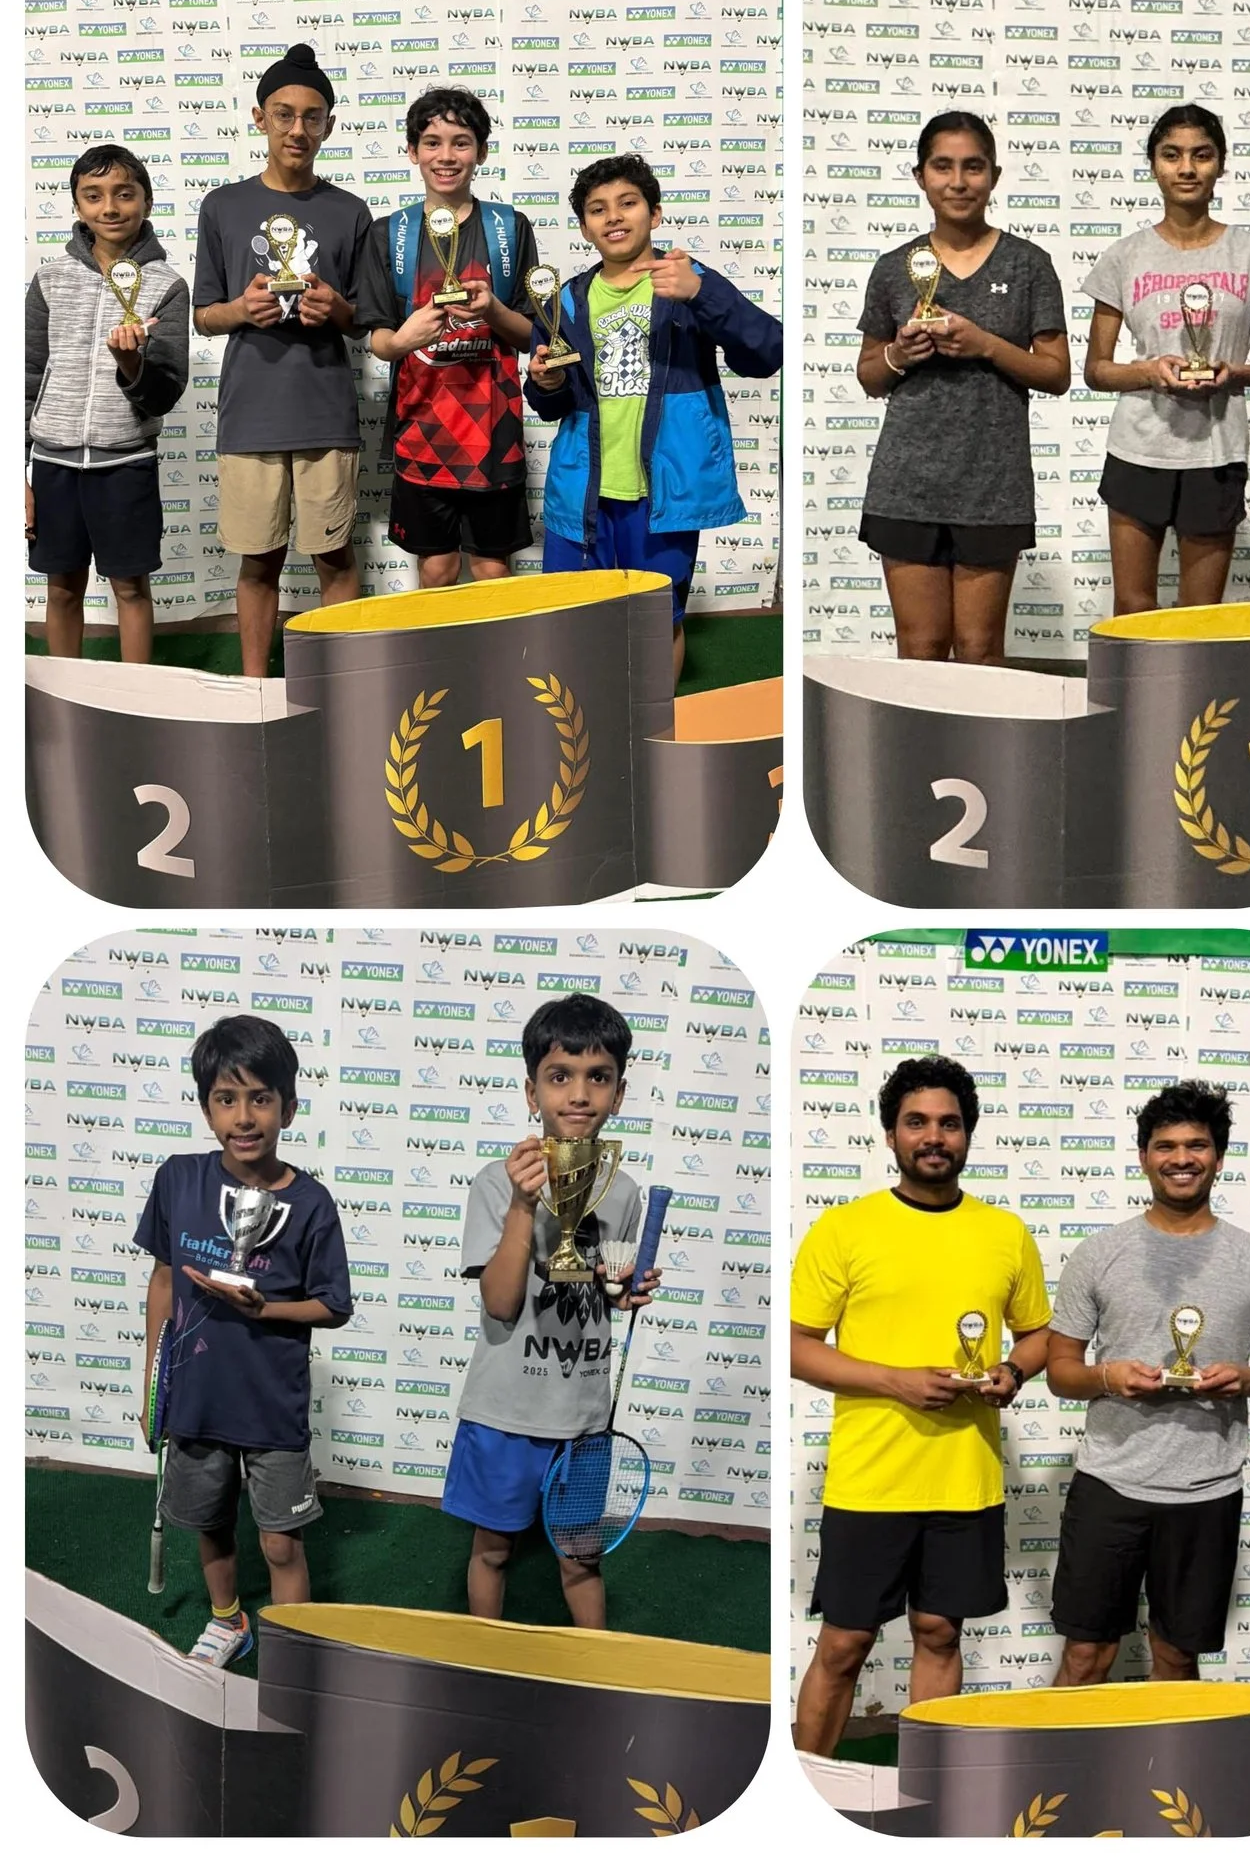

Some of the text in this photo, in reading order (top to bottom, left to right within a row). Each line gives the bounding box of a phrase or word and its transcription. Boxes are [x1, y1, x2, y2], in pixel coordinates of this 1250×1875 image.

[297, 15, 343, 25] NWBA
[431, 217, 453, 226] NWBA
[496, 227, 510, 277] HUNDRED
[531, 276, 554, 286] NWBA
[461, 718, 504, 807] 1
[133, 784, 196, 878] 2
[930, 778, 988, 869] 2
[421, 932, 481, 949] NWBA
[514, 938, 555, 955] YONEX
[110, 948, 169, 965] NWBA
[1022, 939, 1098, 965] YONEX
[201, 956, 238, 972] YONEX
[880, 975, 937, 988] NWBA
[971, 978, 1003, 991] YONEX
[1148, 983, 1178, 997] YONEX
[524, 1335, 611, 1363] NWBA
[523, 1366, 549, 1376] 2025
